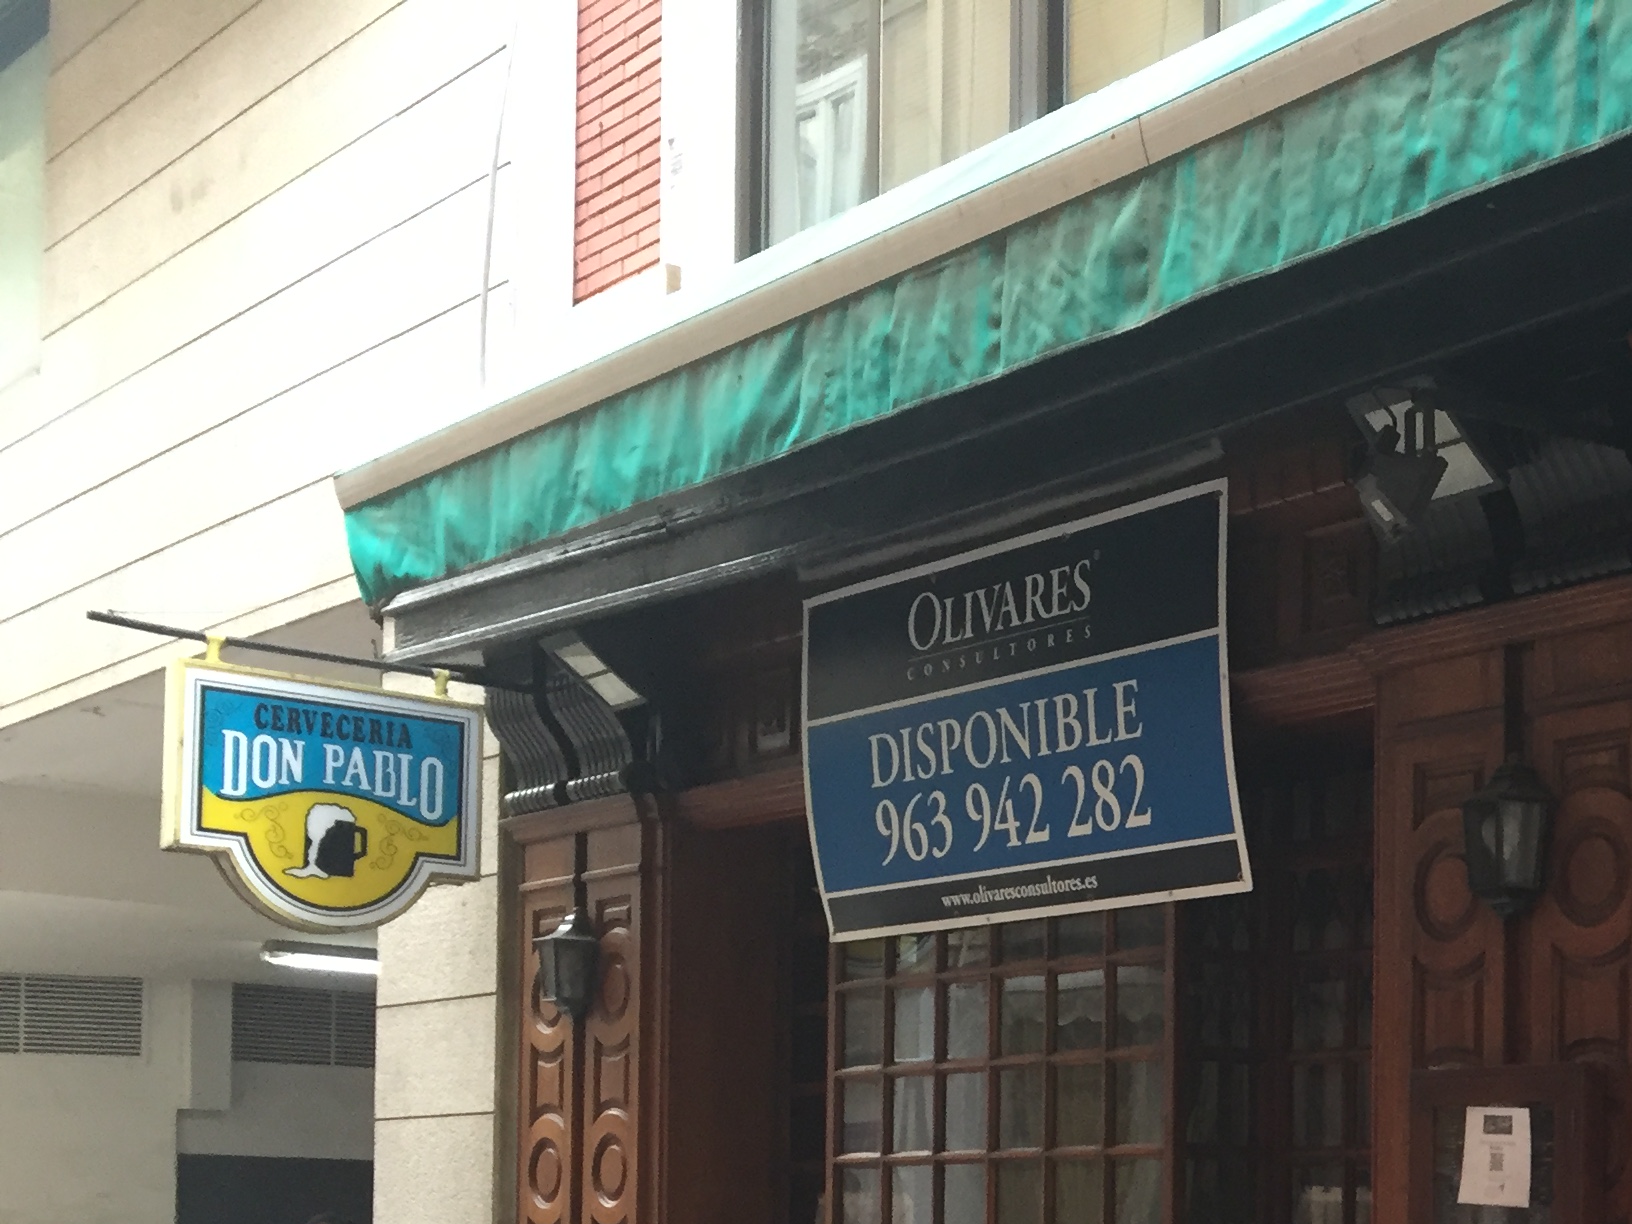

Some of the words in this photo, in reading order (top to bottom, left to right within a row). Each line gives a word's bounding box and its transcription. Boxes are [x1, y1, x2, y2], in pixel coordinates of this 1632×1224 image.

[908, 559, 1092, 651] OLIVARES
[906, 624, 1093, 681] CONSULTORES
[254, 703, 413, 748] CERVECERIA
[868, 678, 1144, 789] DISPONIBLE
[220, 729, 305, 797] DON
[322, 743, 445, 820] PABLO
[875, 789, 954, 867] 963
[965, 772, 1051, 853] 942
[1061, 753, 1152, 839] 282
[940, 874, 1099, 907] www.olivaresconsultores.es
